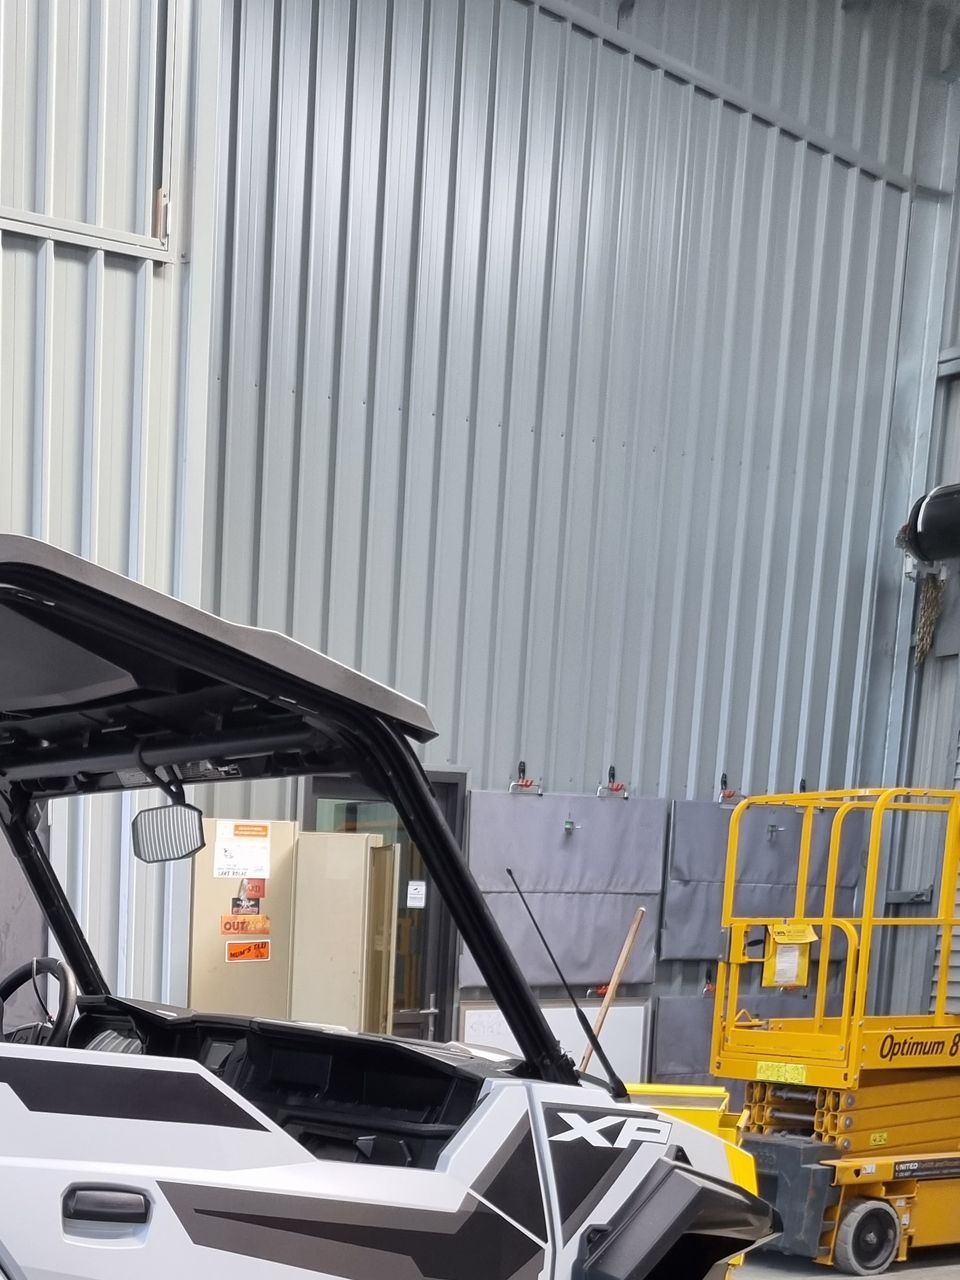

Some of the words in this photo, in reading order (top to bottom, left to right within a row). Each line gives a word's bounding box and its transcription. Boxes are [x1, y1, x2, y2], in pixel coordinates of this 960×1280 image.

[880, 1034, 945, 1062] Optimum
[548, 1112, 672, 1148] XP
[895, 1162, 919, 1171] UNITED
